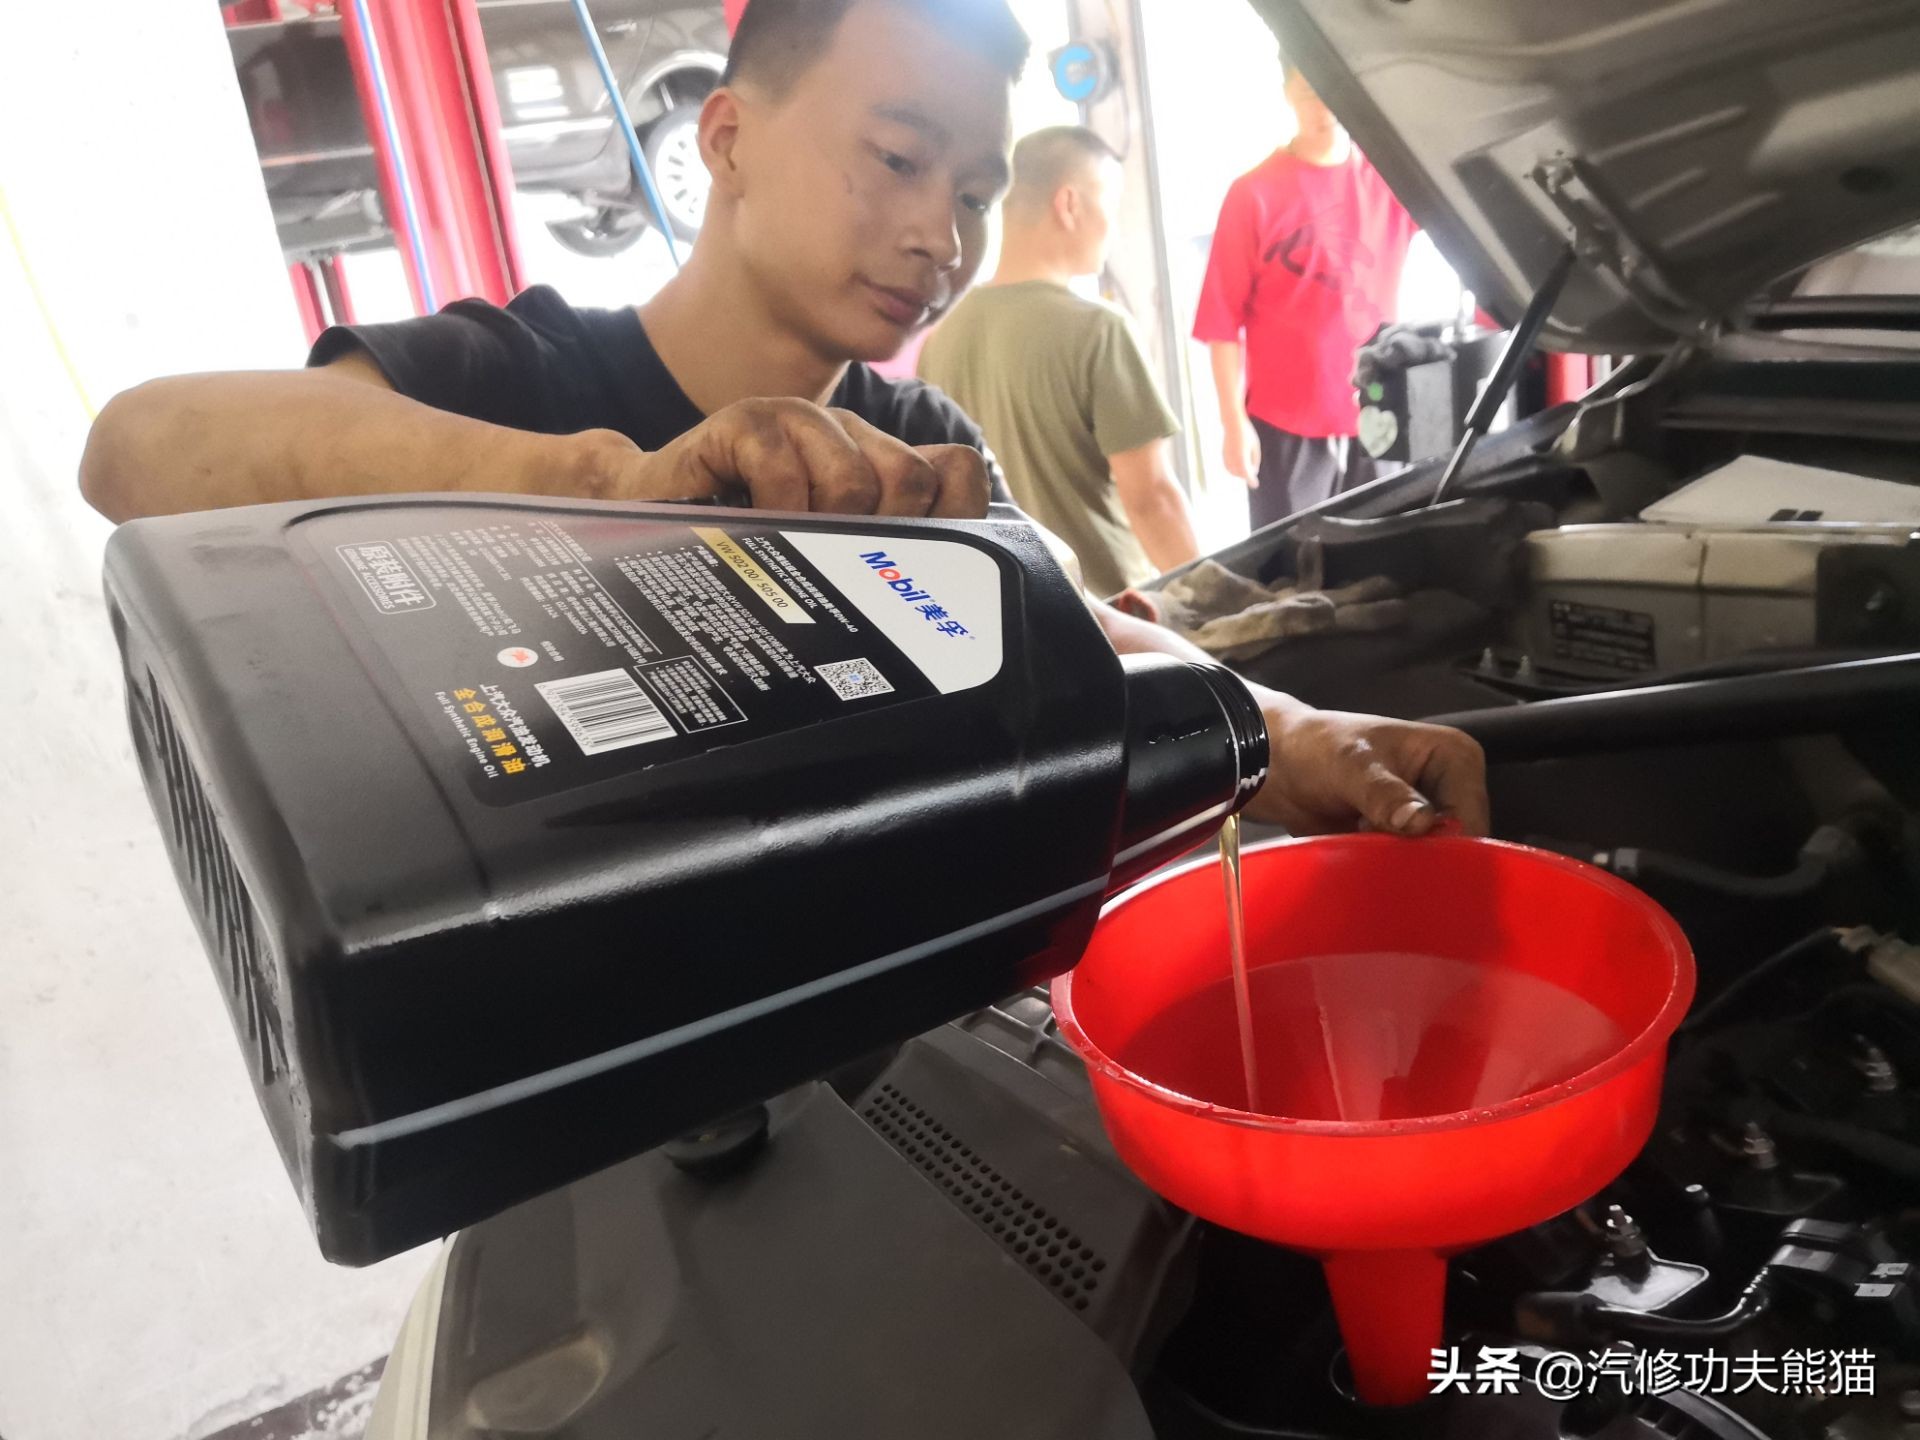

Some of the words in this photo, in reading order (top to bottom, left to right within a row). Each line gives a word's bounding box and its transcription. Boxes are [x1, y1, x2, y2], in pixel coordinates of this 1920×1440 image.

[358, 545, 425, 606] 原装附件
[361, 572, 395, 610] ACCESSORIES
[716, 541, 735, 554] VW
[729, 554, 749, 568] 502
[757, 582, 777, 597] 505
[772, 598, 789, 608] 00
[742, 537, 759, 551] FULL
[755, 549, 788, 579] SYNTHETIC
[784, 578, 810, 599] ENGINE
[804, 599, 818, 609] OIL
[859, 551, 932, 602] Mobil
[914, 603, 970, 638] 美孚
[435, 691, 451, 706] Full
[444, 704, 471, 738] Synthetic
[466, 737, 489, 765] Engine
[483, 764, 500, 779] Oil
[453, 688, 526, 774] 全合成润滑油
[479, 684, 551, 768] 上汽大众汽油发动机
